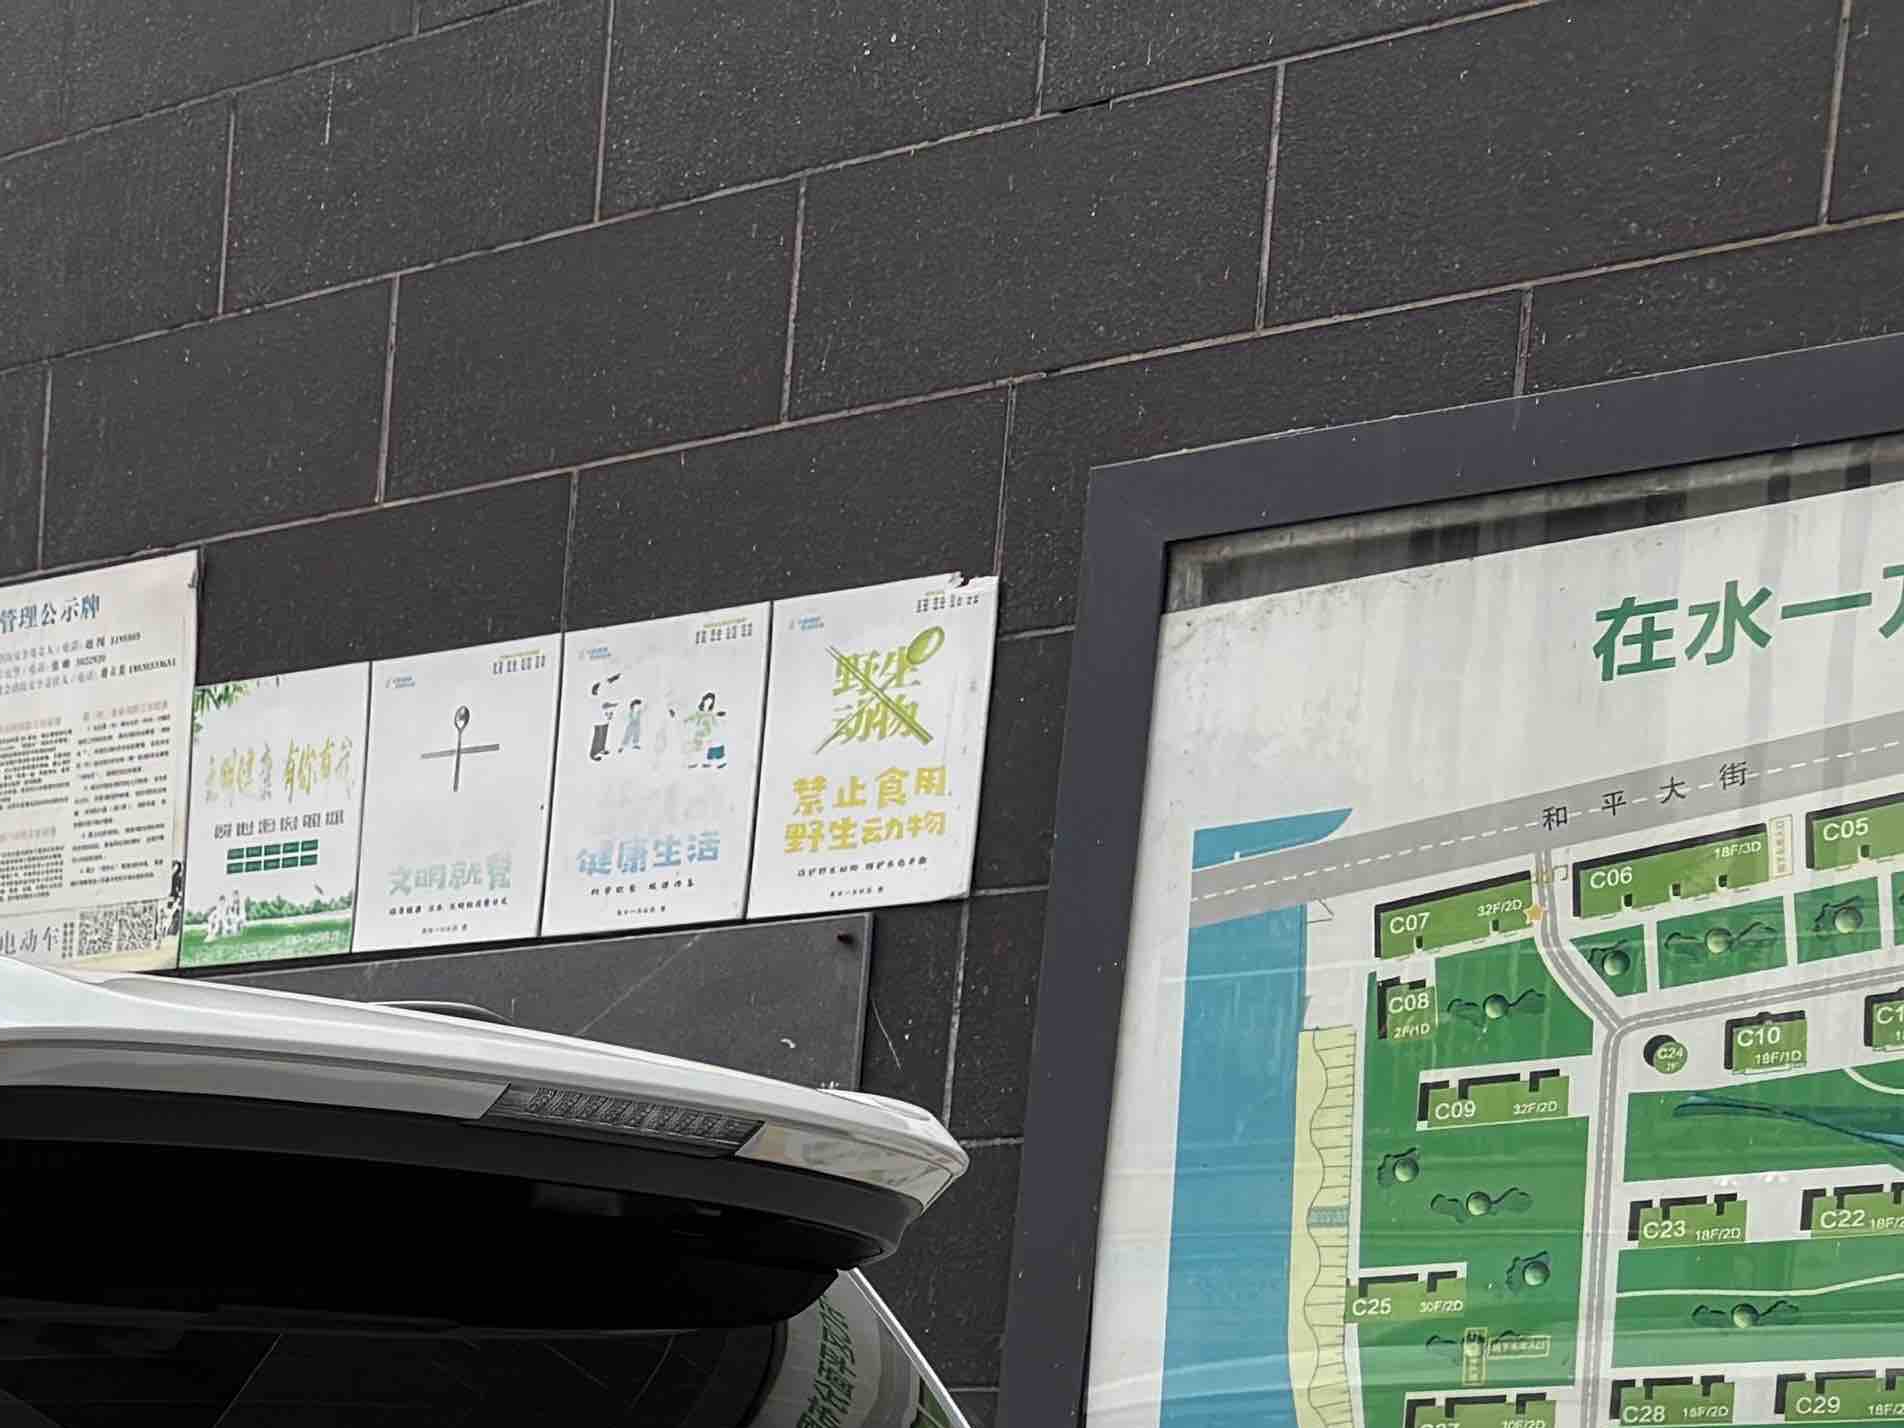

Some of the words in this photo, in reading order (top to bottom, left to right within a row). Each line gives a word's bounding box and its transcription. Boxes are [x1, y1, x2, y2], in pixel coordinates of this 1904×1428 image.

[792, 765, 950, 816] 禁止食用
[1542, 760, 1748, 832] 和平大街
[784, 809, 946, 854] 野生动物
[1824, 818, 1870, 841] C05
[575, 829, 721, 877] 健康生活
[1590, 865, 1633, 890] C06
[1389, 912, 1431, 935] C07
[1388, 992, 1430, 1014] C08
[1876, 1006, 1904, 1025] C1
[1737, 1026, 1782, 1048] C10
[1435, 1100, 1477, 1120] C09
[1643, 1220, 1686, 1240] C23
[1820, 1209, 1866, 1229] C22
[1870, 1215, 1904, 1230] 18F/2
[1352, 1297, 1392, 1317] C25
[1623, 1404, 1666, 1424] C28
[1795, 1396, 1841, 1416] C29
[1868, 1402, 1904, 1418] 18F/2
